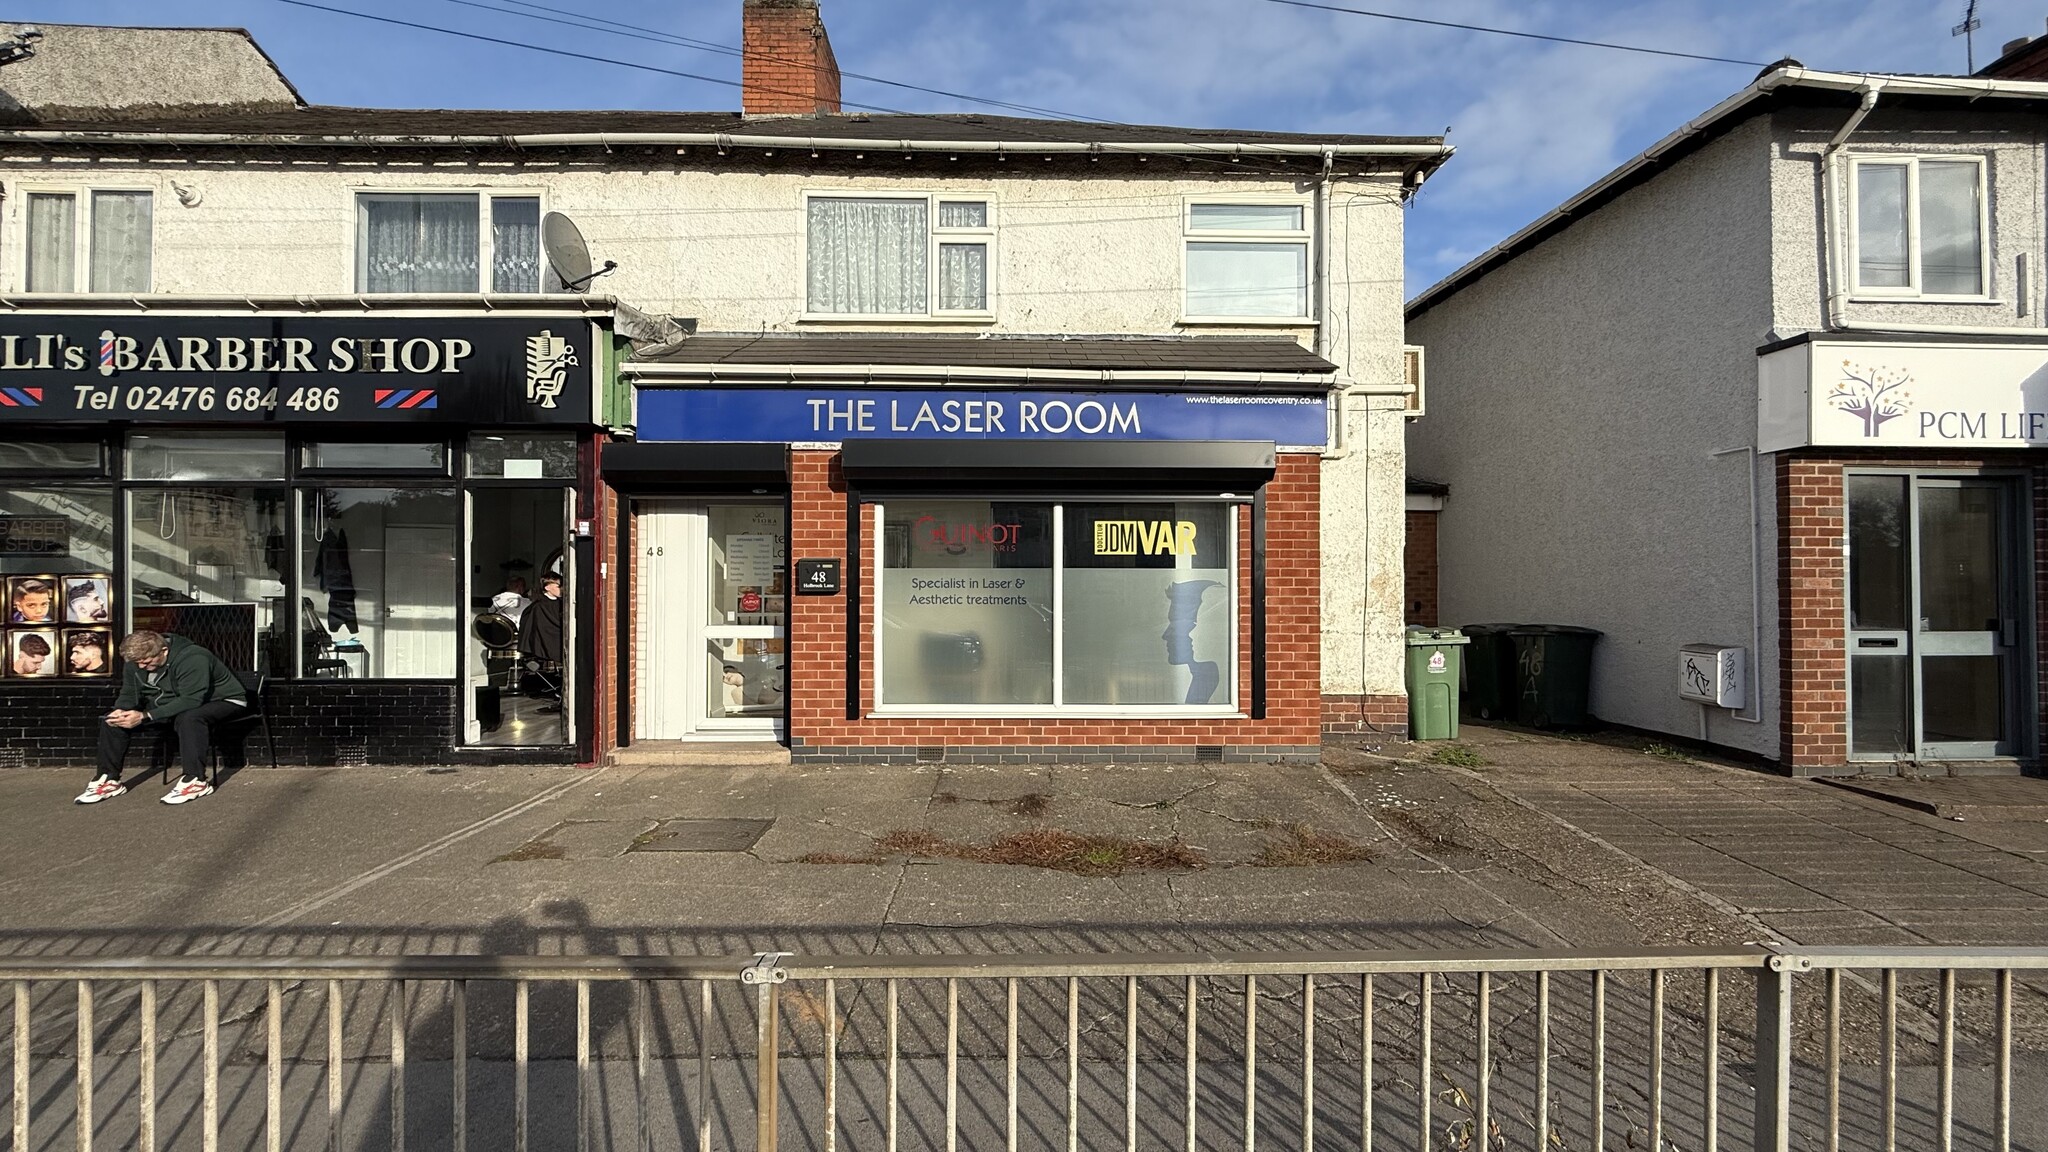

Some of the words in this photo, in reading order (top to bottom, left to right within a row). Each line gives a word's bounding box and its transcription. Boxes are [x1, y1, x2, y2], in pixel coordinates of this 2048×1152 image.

[114, 336, 319, 372] BARBER
[328, 337, 472, 373] SHOP
[74, 385, 119, 410] Tel
[126, 386, 216, 411] 02476
[226, 387, 278, 411] 684
[286, 387, 340, 411] 486
[1186, 395, 1323, 406] www.thelaserroomcoventry.co.uk
[806, 399, 876, 431] THE
[892, 400, 1006, 433] LASER
[1020, 401, 1142, 434] ROOM
[1919, 411, 1987, 439] PCM
[2001, 412, 2048, 440] LIF
[0, 520, 66, 535] BARBER
[912, 515, 1022, 545] GUINOT
[6, 538, 57, 552] SHOP
[647, 546, 664, 557] 48
[811, 571, 827, 583] 48
[911, 577, 966, 590] Specialist
[969, 577, 979, 588] in
[982, 578, 1013, 588] Laser
[1015, 578, 1026, 588] &
[909, 594, 963, 605] Aesthetic
[966, 595, 1027, 605] treatments
[1432, 657, 1442, 665] 48
[1522, 675, 1539, 703] A
